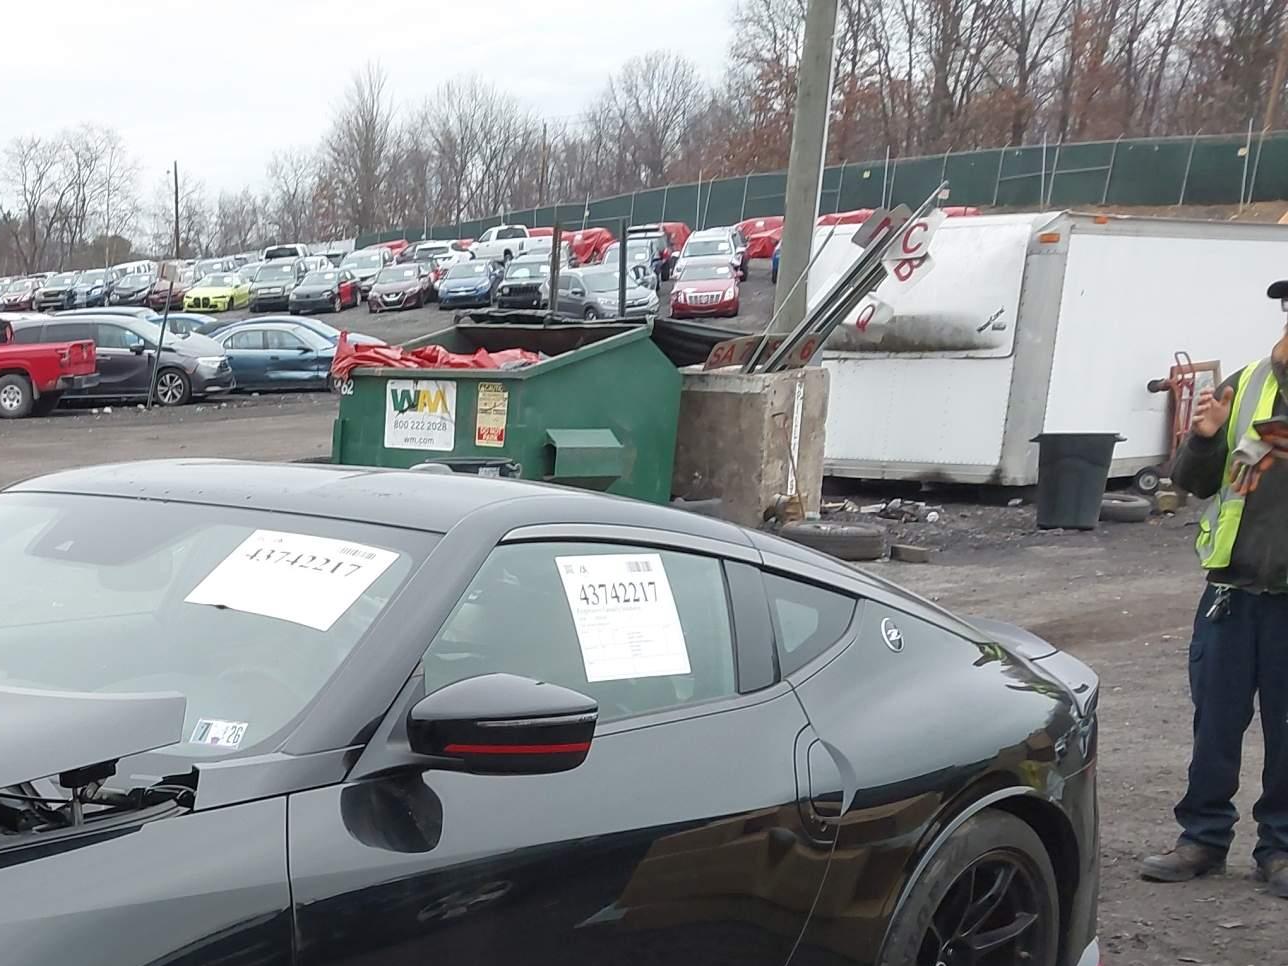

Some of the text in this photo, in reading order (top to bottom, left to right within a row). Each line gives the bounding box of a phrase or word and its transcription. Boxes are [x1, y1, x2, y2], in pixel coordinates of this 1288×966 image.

[902, 222, 929, 254] C
[856, 304, 876, 332] Q
[391, 389, 449, 413] WM
[394, 420, 447, 432] 800 222 2028
[404, 436, 435, 446] wm.com
[244, 548, 363, 578] 43742217
[579, 581, 658, 606] 43742217
